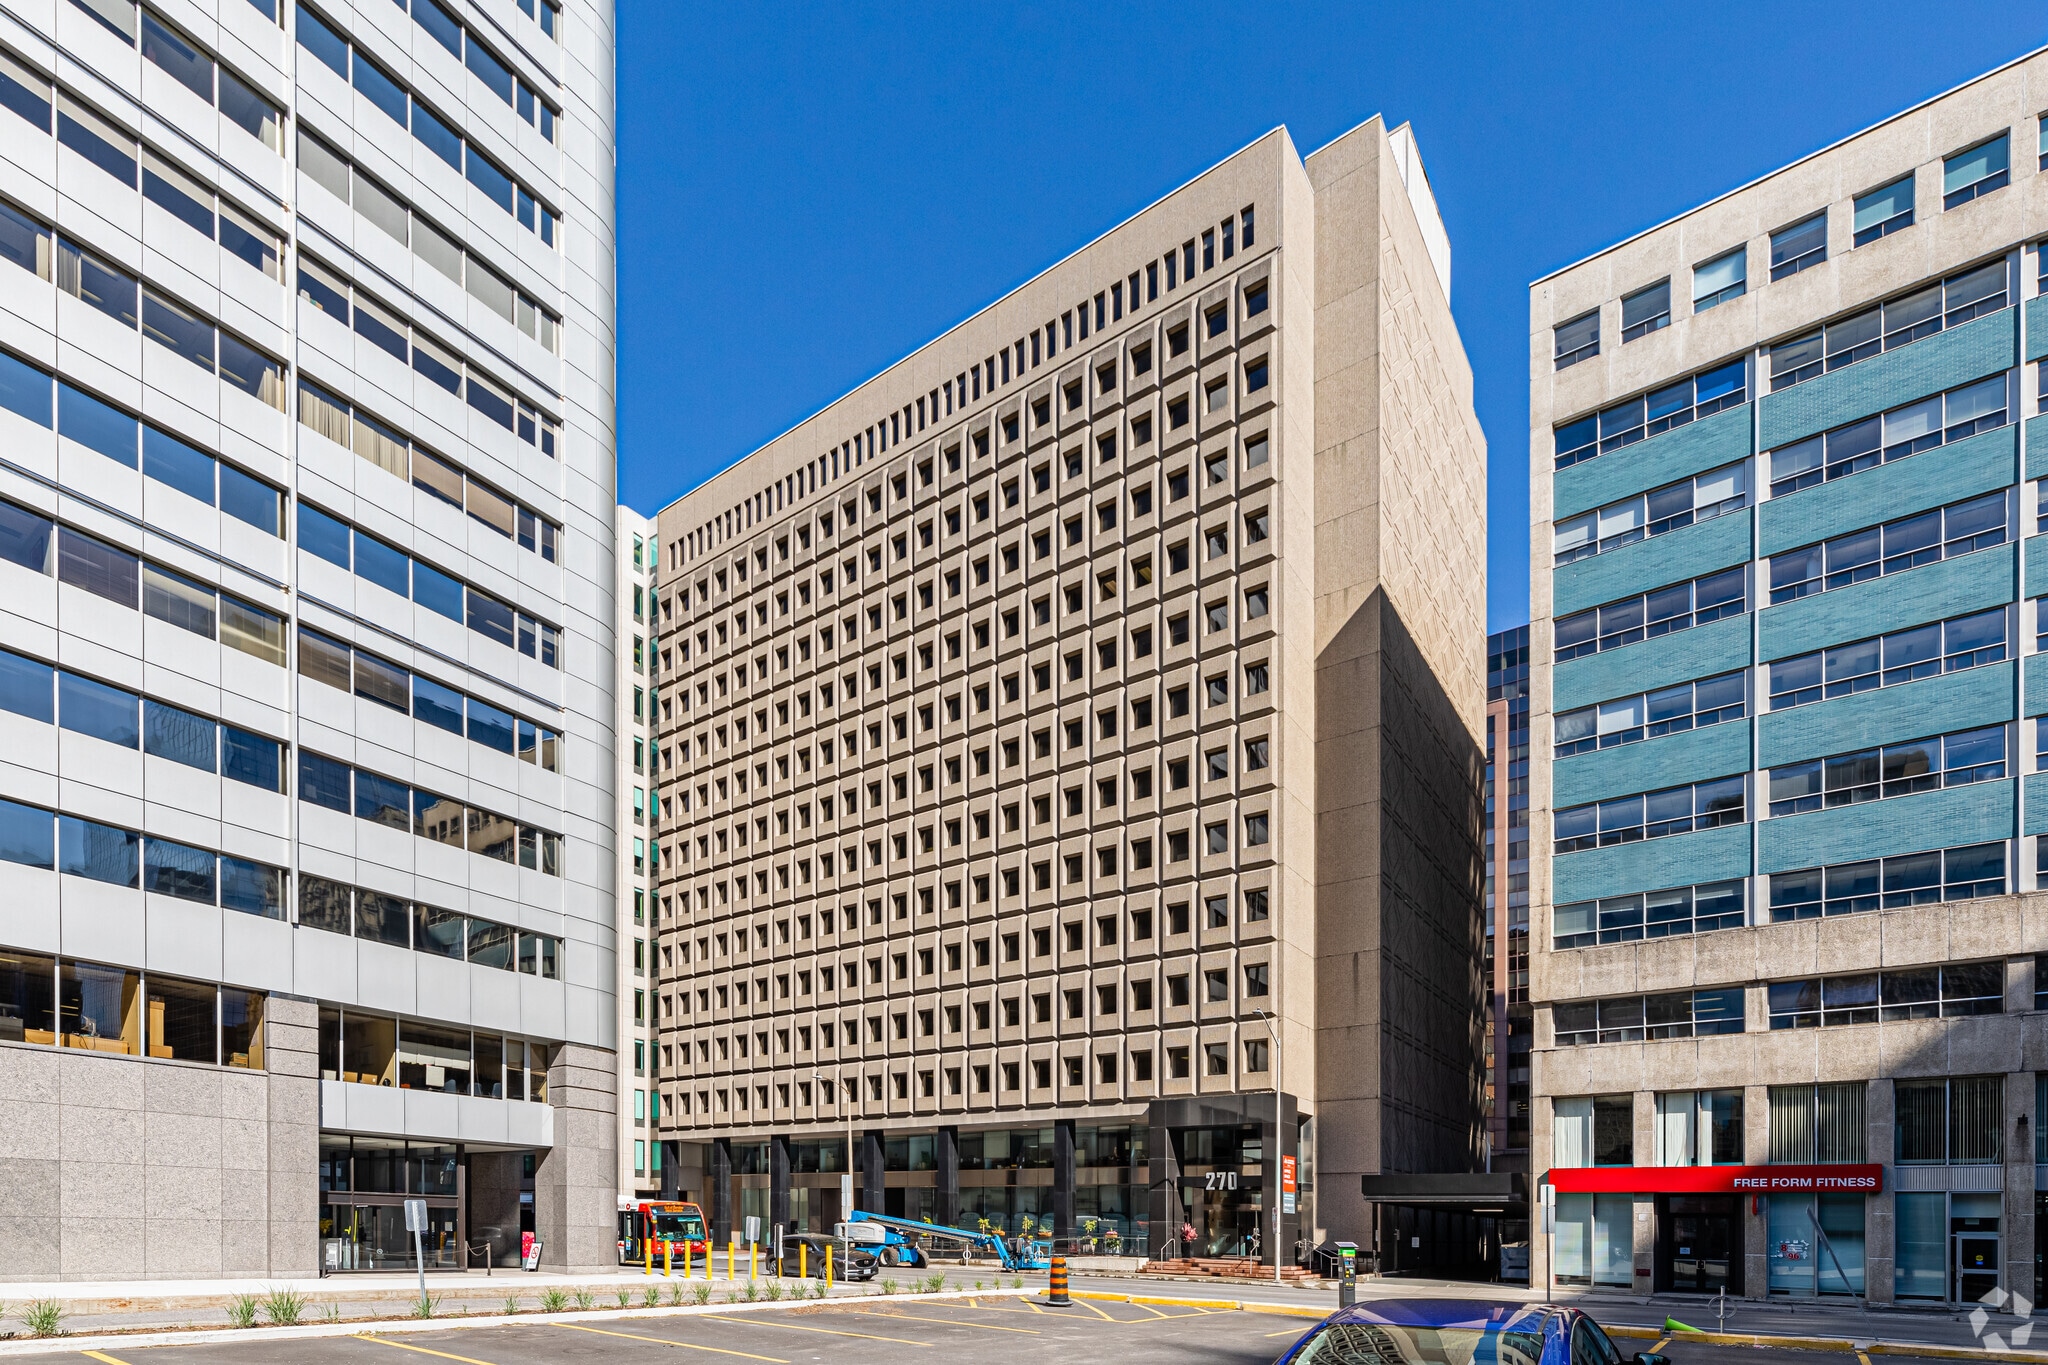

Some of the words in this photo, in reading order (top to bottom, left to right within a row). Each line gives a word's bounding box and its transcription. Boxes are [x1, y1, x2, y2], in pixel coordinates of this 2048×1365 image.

[1205, 1172, 1237, 1190] 270
[1733, 1178, 1768, 1187] FREE
[1771, 1178, 1812, 1187] FORM
[1816, 1177, 1876, 1187] FITNESS
